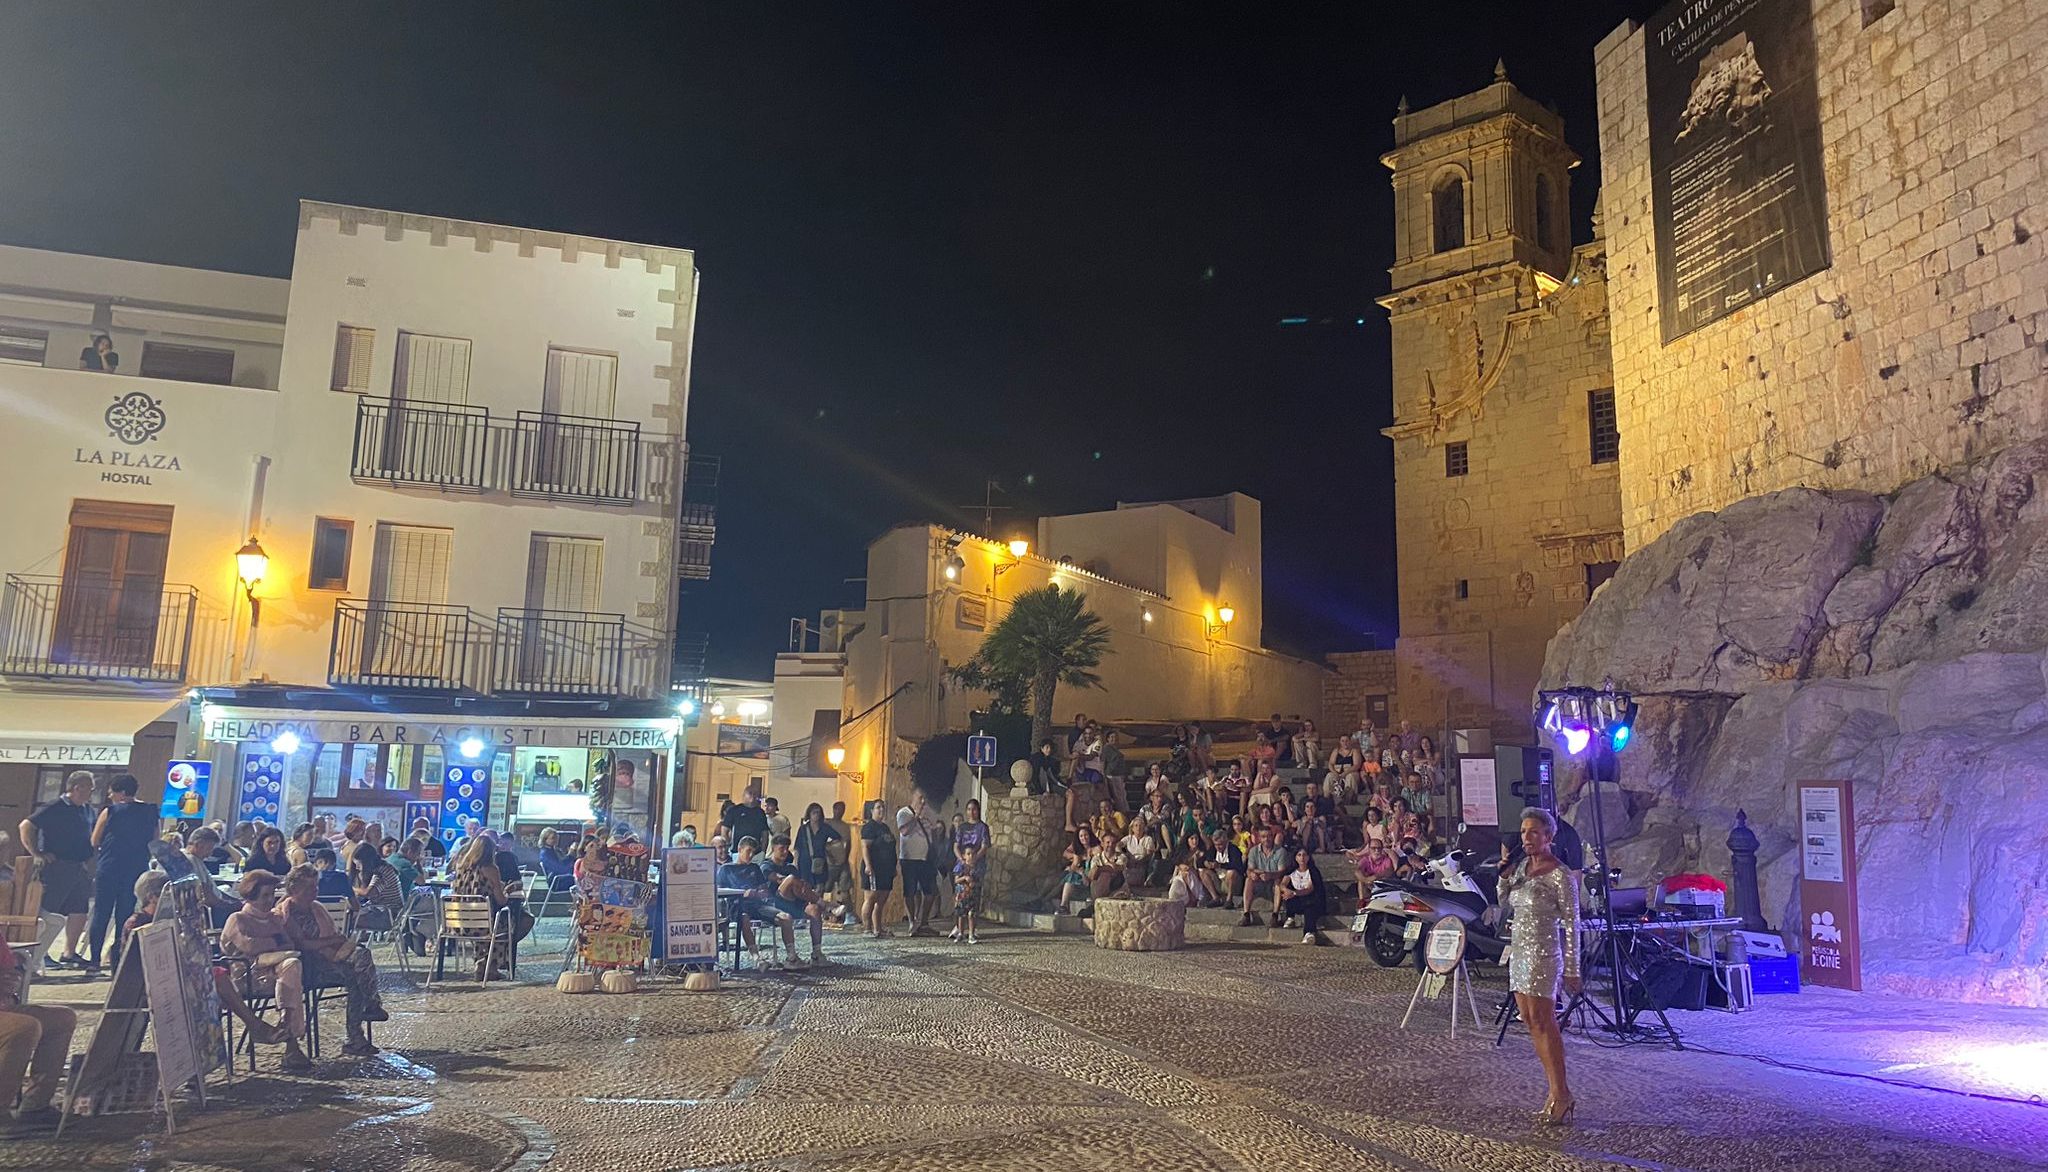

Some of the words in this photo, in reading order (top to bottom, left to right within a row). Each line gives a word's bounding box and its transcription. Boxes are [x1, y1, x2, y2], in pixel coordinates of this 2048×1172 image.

[1671, 22, 1710, 57] CASTILLO
[75, 448, 104, 464] LA
[110, 451, 182, 471] PLAZA
[100, 472, 152, 485] HOSTAL
[350, 724, 406, 743] BAR
[577, 729, 667, 747] HELADERIA
[24, 746, 50, 760] LA
[58, 746, 120, 761] PLAZA
[670, 924, 700, 937] SANGRIA
[1820, 955, 1840, 969] CINE
